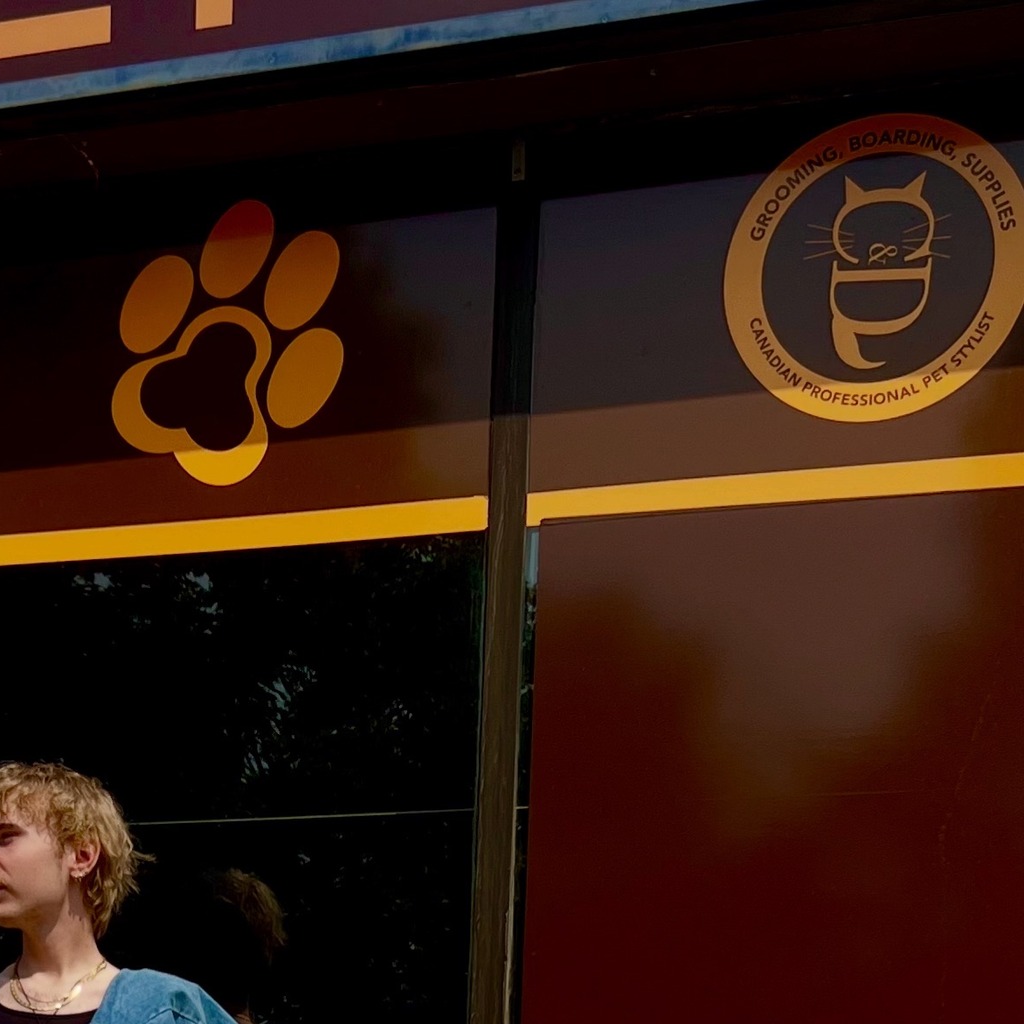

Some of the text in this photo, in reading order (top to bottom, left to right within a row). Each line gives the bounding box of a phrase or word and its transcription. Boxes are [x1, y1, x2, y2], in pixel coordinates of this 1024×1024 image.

[750, 128, 1016, 242] GROOMING, BOARDING, SUPPLIES
[749, 311, 994, 407] CANADIAN PROFESSIONAL PET STYLIST
